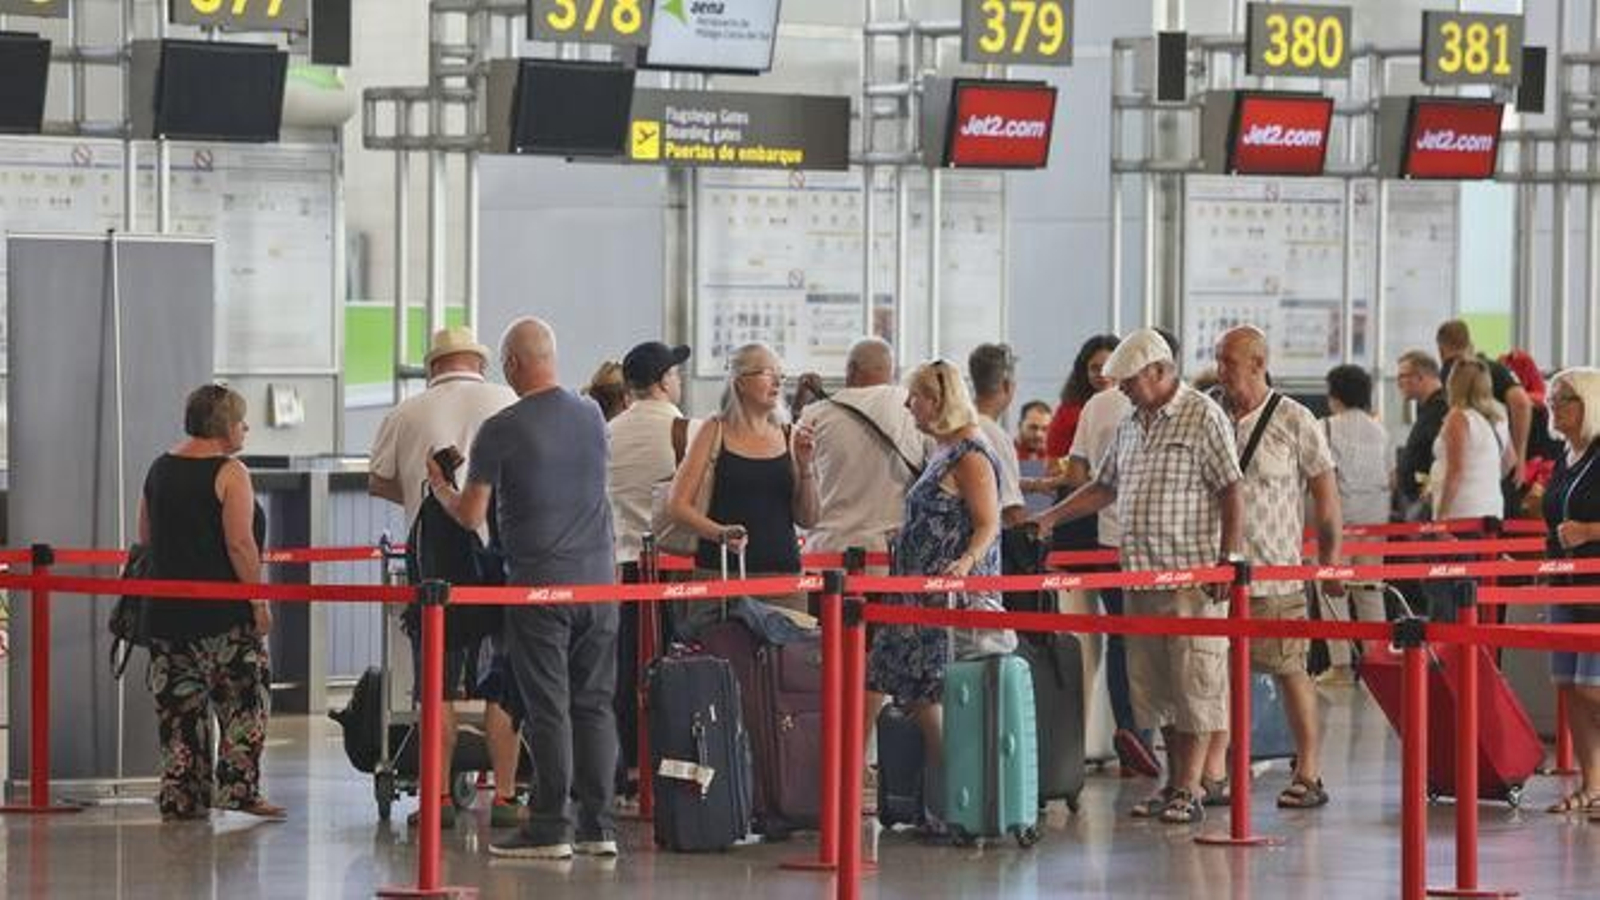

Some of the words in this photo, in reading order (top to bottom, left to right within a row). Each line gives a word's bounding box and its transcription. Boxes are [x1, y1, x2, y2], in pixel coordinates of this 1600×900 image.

[690, 1, 724, 14] aena
[547, 0, 641, 34] 378
[979, 0, 1065, 55] 379
[1264, 15, 1344, 68] 380
[1438, 22, 1511, 75] 381
[961, 114, 1045, 138] Jet2.com
[1243, 125, 1322, 148] Jet2.com
[1416, 129, 1492, 151] Jet2.com
[665, 141, 715, 160] Puertas
[718, 143, 735, 161] de
[738, 145, 803, 166] embarque
[1155, 571, 1195, 584] Jet2.com
[1316, 567, 1355, 579] Jet2.com
[1428, 564, 1467, 577] Jet2.com
[663, 583, 708, 598] Jet2.com
[923, 577, 965, 591] Jet2.com
[1042, 576, 1082, 588] Jet2.com
[527, 588, 573, 601] Jet2.com
